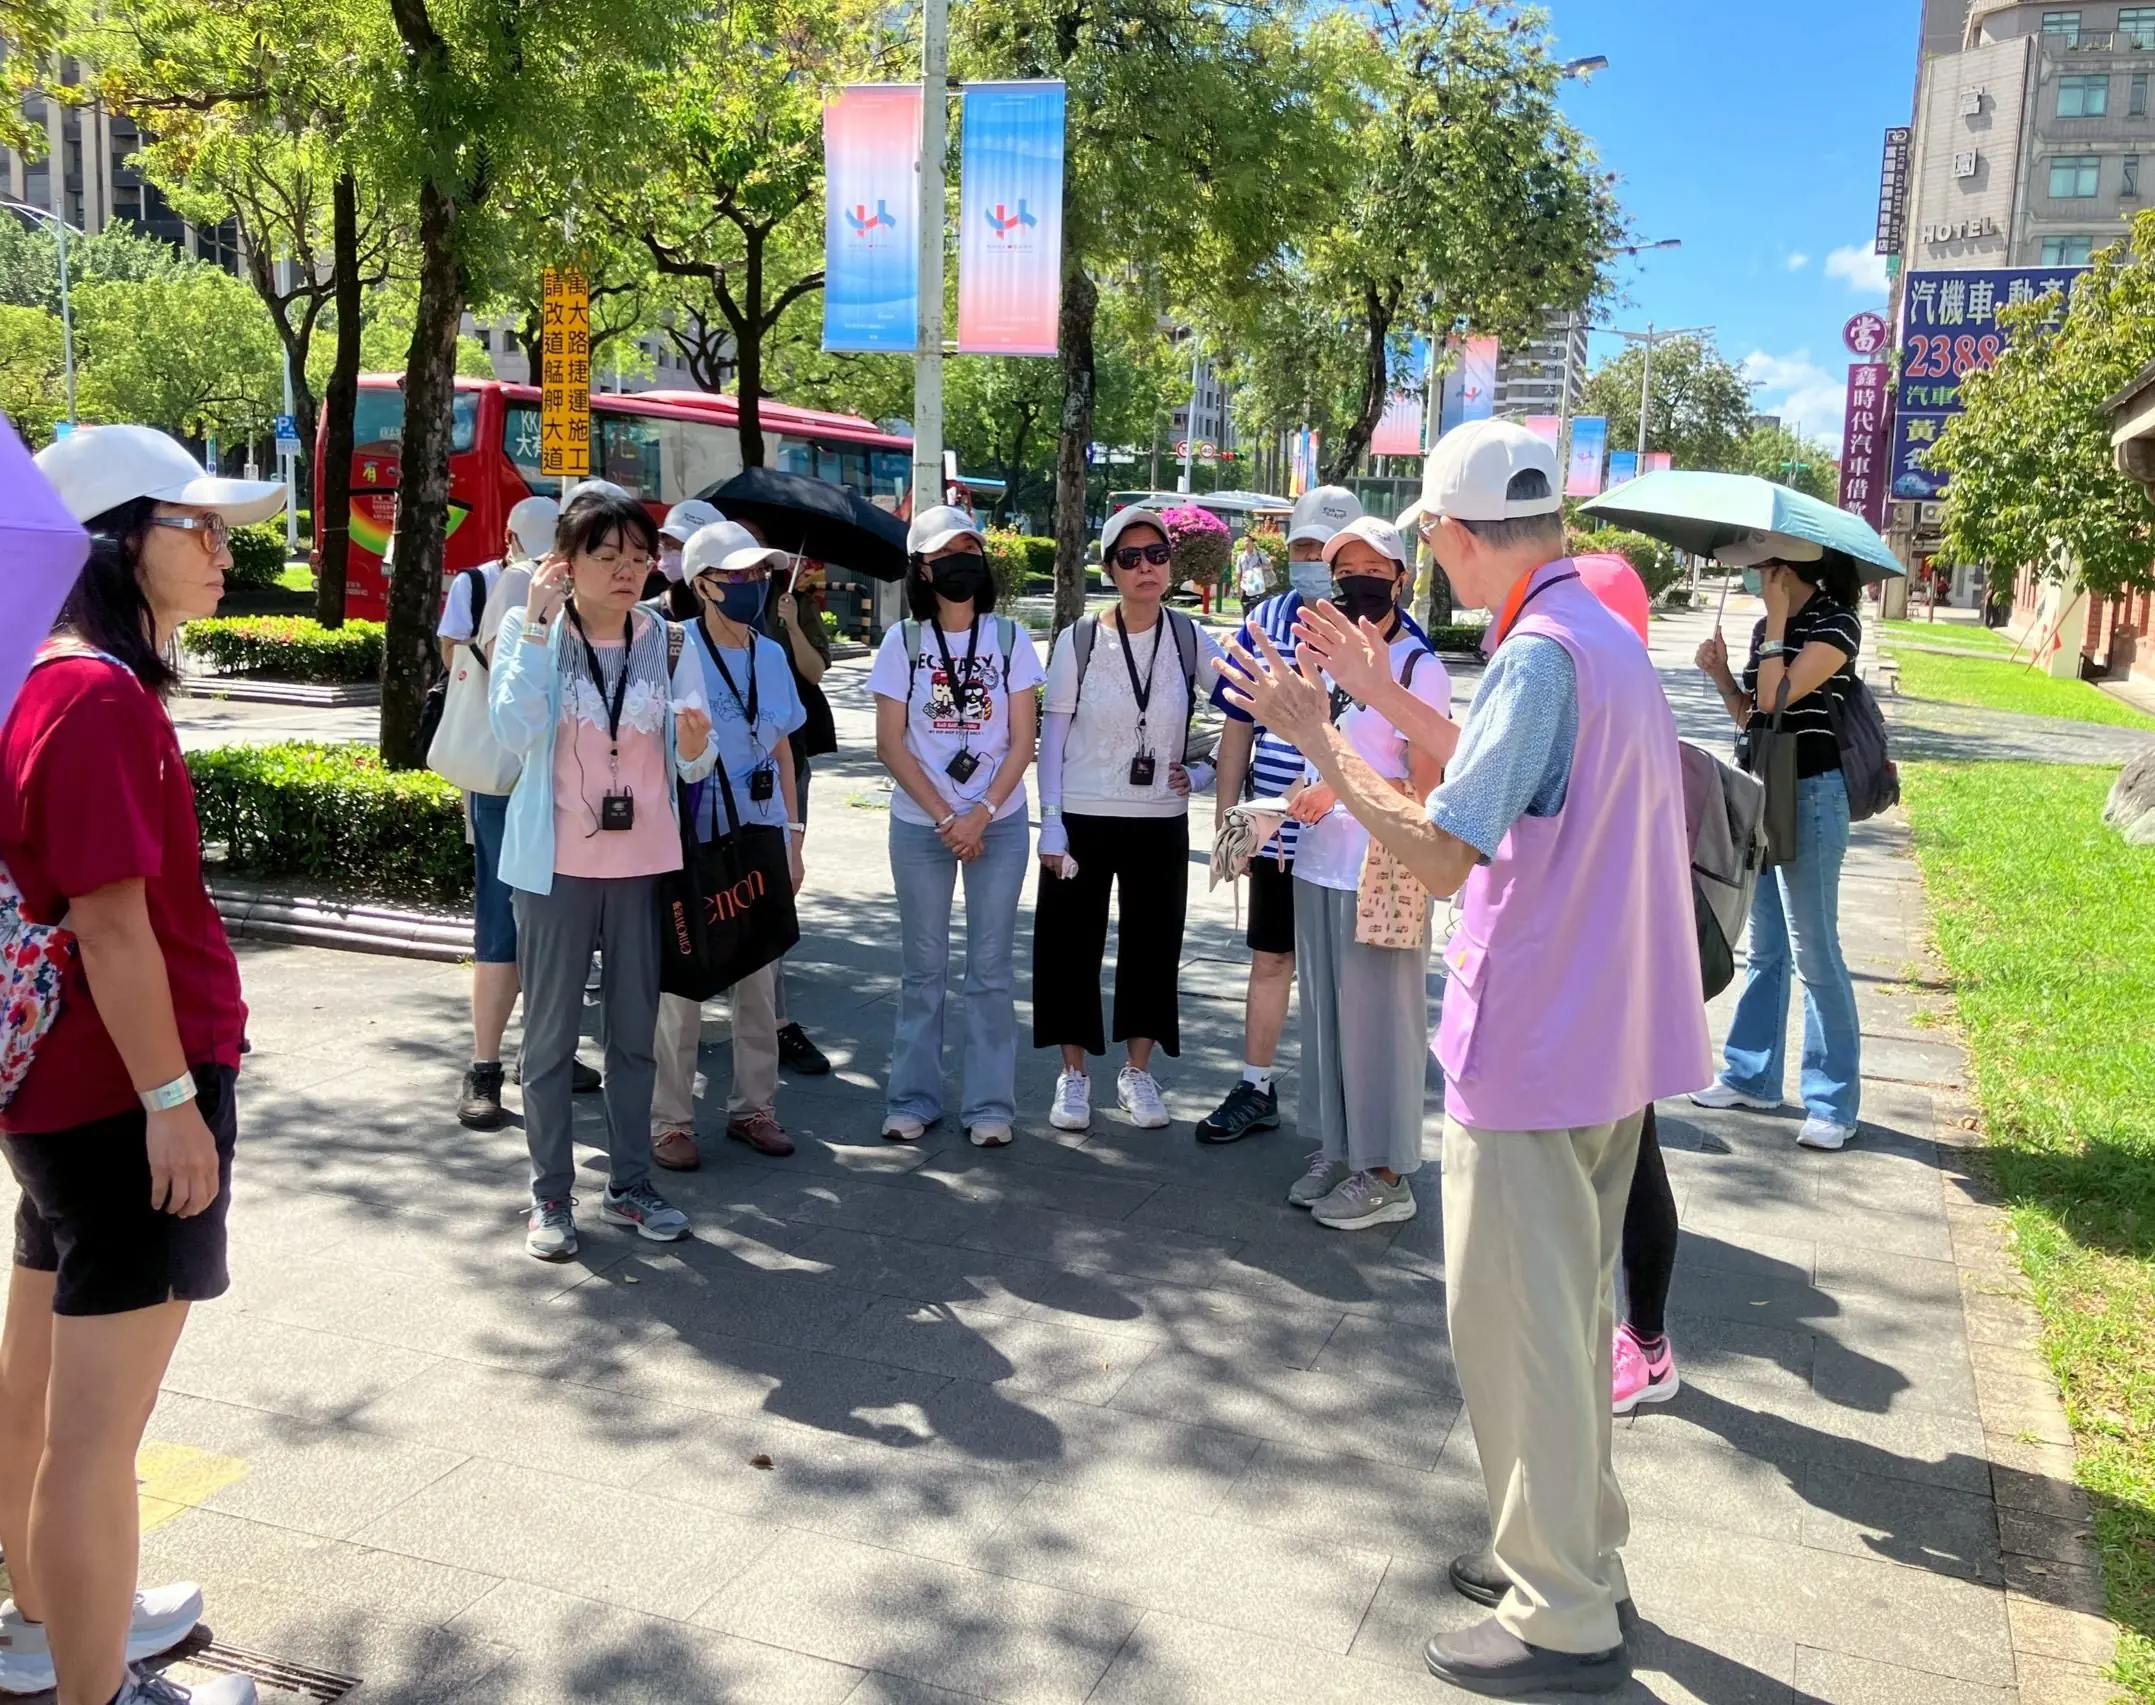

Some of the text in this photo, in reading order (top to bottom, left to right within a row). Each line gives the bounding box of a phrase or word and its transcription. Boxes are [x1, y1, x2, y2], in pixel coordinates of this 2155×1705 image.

[1921, 217, 1995, 244] HOTEL
[544, 273, 564, 471] 請改道艋舺大道
[567, 272, 588, 471] 萬大路捷運施工
[1850, 315, 1881, 352] 當
